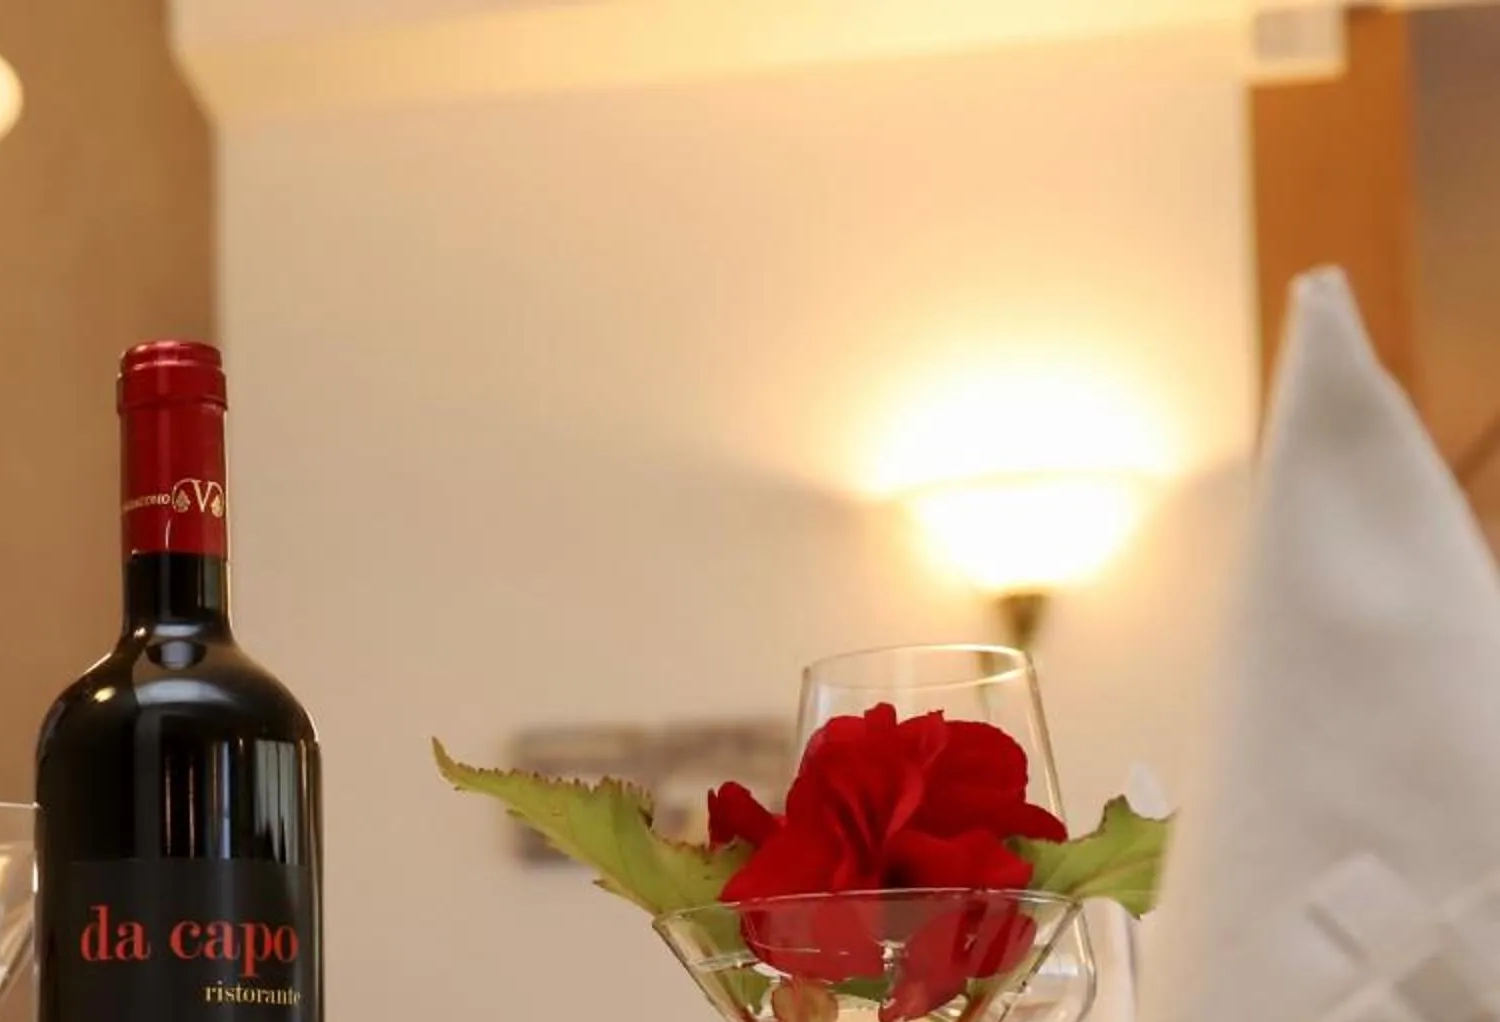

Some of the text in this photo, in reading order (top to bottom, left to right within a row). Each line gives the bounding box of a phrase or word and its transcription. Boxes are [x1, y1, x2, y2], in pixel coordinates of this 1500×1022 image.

[80, 905, 298, 978] da capo
[204, 980, 301, 1005] ristorante
